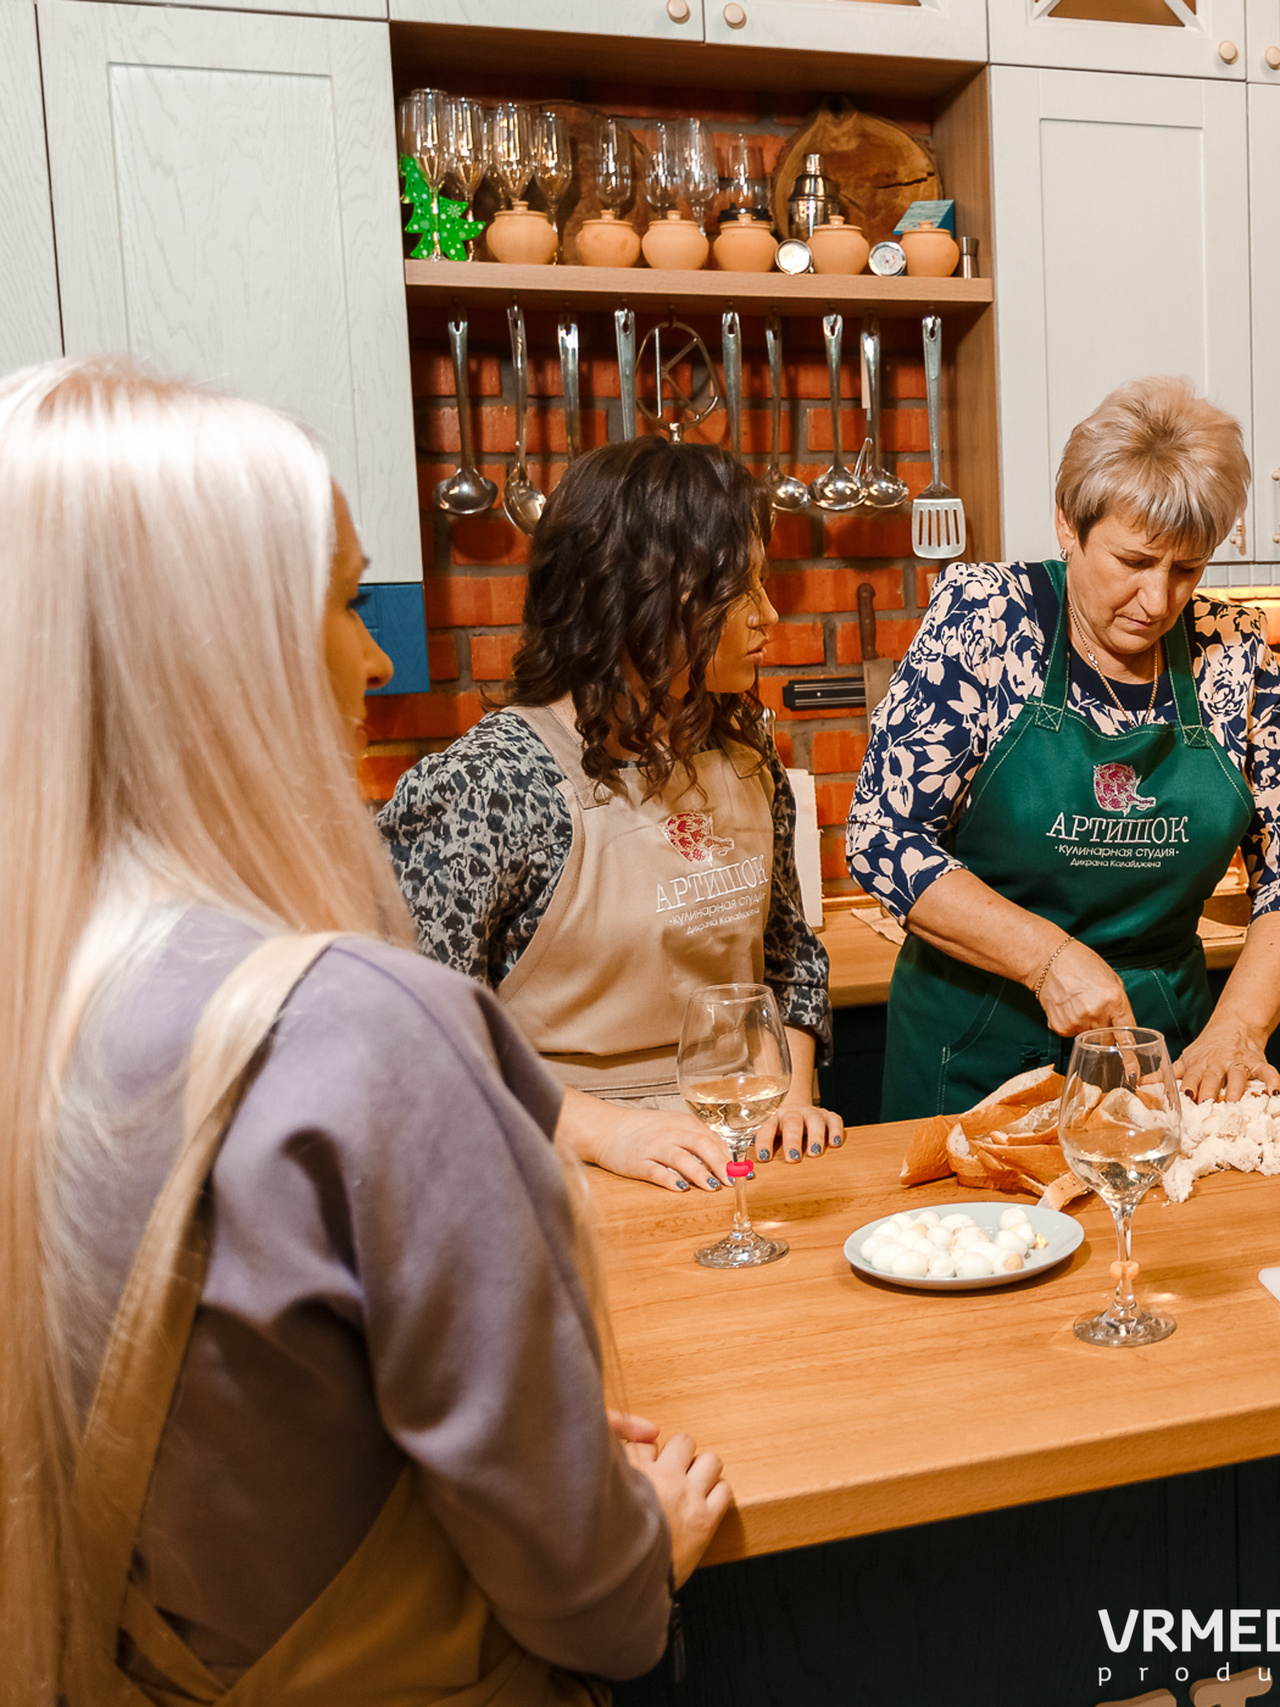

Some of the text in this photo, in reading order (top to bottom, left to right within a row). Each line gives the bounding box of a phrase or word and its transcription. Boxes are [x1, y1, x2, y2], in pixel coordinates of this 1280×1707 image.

[1046, 812, 1189, 844] АРТИШОК
[1135, 847, 1175, 859] студия
[656, 854, 769, 912] АРТИШОК
